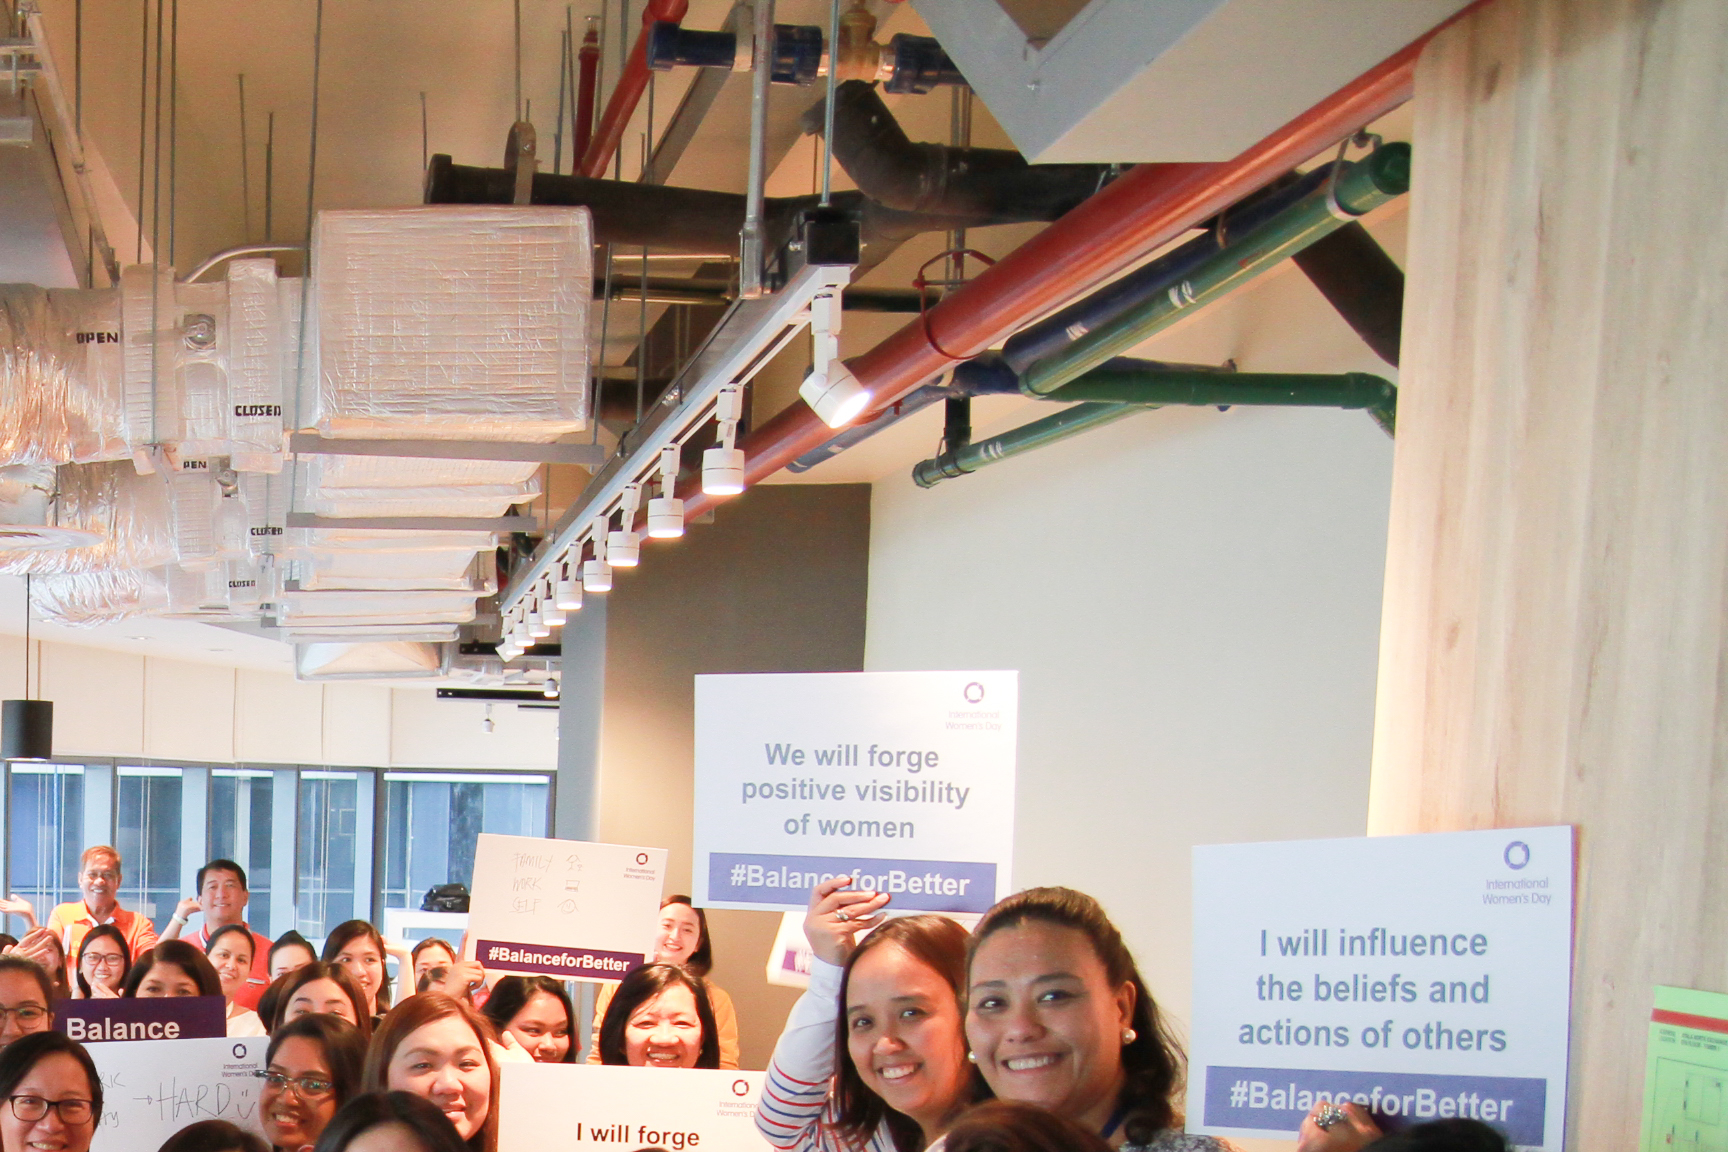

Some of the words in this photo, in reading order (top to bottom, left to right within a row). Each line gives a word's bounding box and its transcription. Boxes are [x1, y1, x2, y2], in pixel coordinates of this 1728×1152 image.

[76, 331, 119, 344] OPEN
[235, 404, 282, 417] CLOSED
[250, 526, 283, 536] CLOSED
[948, 710, 1000, 720] International
[985, 721, 1002, 732] Day
[765, 743, 805, 766] We
[814, 744, 859, 767] will
[868, 744, 940, 774] forge
[741, 777, 846, 805] positive
[855, 779, 970, 810] visibility
[784, 813, 811, 836] of
[818, 817, 915, 839] women
[1485, 877, 1549, 890] International
[1482, 892, 1529, 905] Women's
[1531, 891, 1552, 906] Day
[1260, 929, 1266, 956] I
[1277, 928, 1327, 956] will
[1339, 927, 1488, 956] influence
[488, 946, 631, 972] #BalanceforBetter
[1256, 974, 1303, 1002] the
[1314, 974, 1417, 1003] beliefs
[1429, 974, 1489, 1004] and
[66, 1017, 180, 1041] Balance
[1238, 1019, 1350, 1048] actions
[1361, 1020, 1394, 1049] of
[1402, 1021, 1507, 1052] others
[156, 1076, 232, 1123] HARD
[577, 1122, 582, 1141] I
[591, 1124, 629, 1143] will
[638, 1125, 700, 1150] forge
